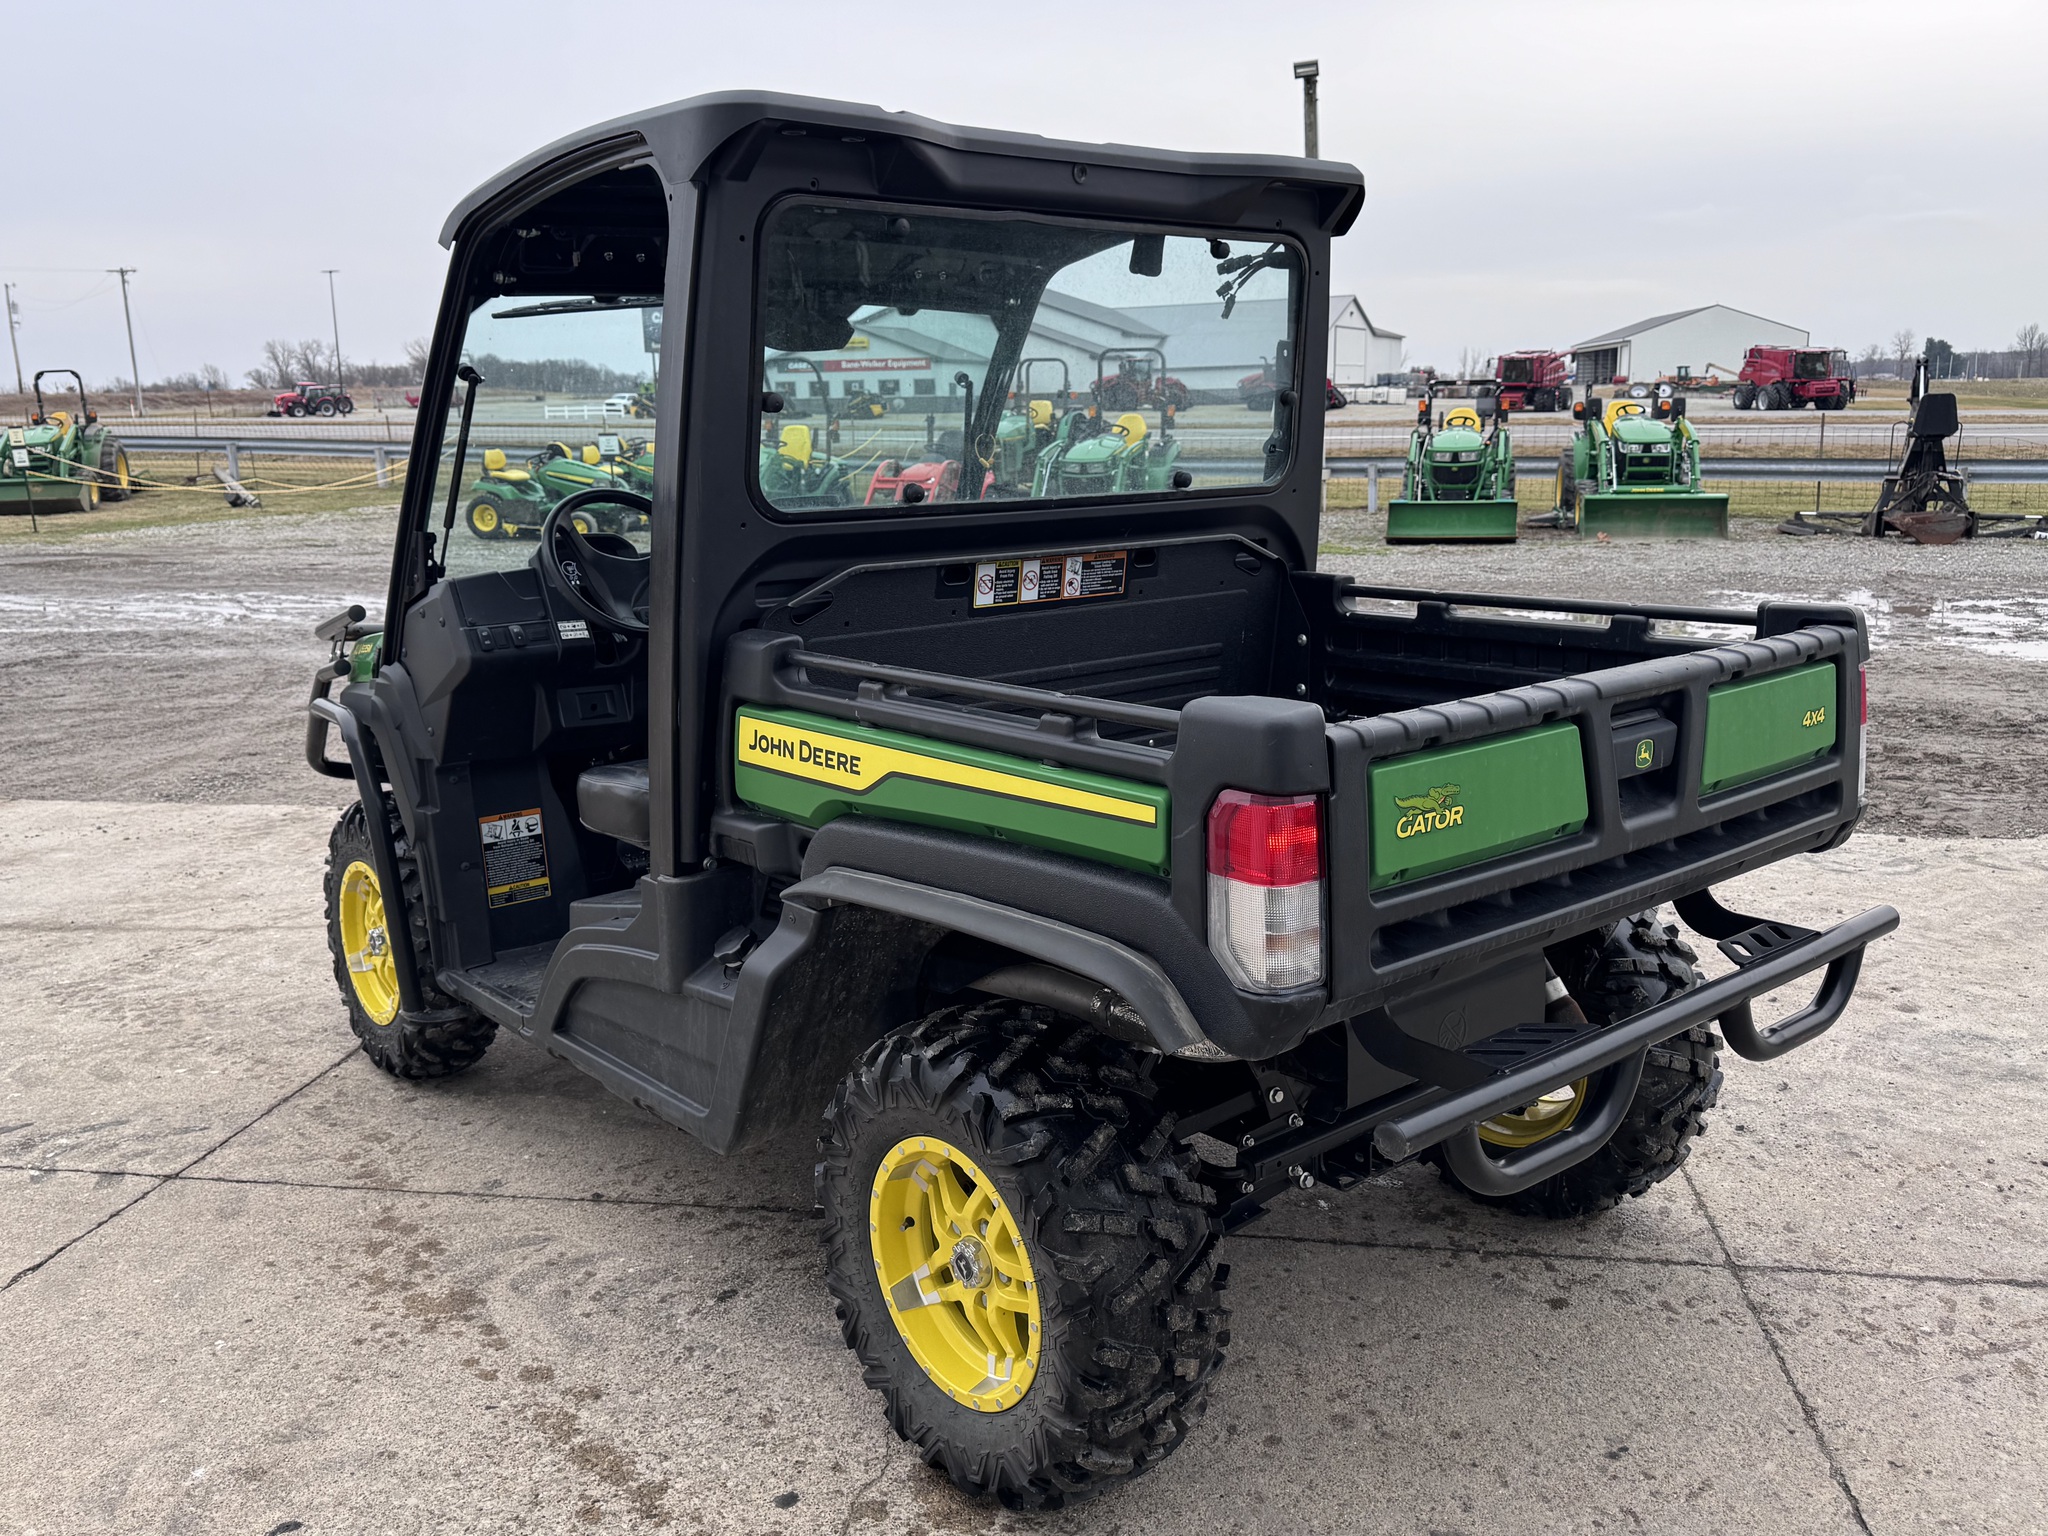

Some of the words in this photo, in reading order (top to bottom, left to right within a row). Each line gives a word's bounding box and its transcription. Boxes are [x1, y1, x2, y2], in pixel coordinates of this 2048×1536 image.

[887, 359, 926, 369] Equipment
[749, 729, 794, 760] JOHN
[799, 740, 860, 776] DEERE
[1396, 805, 1464, 838] GATOR
